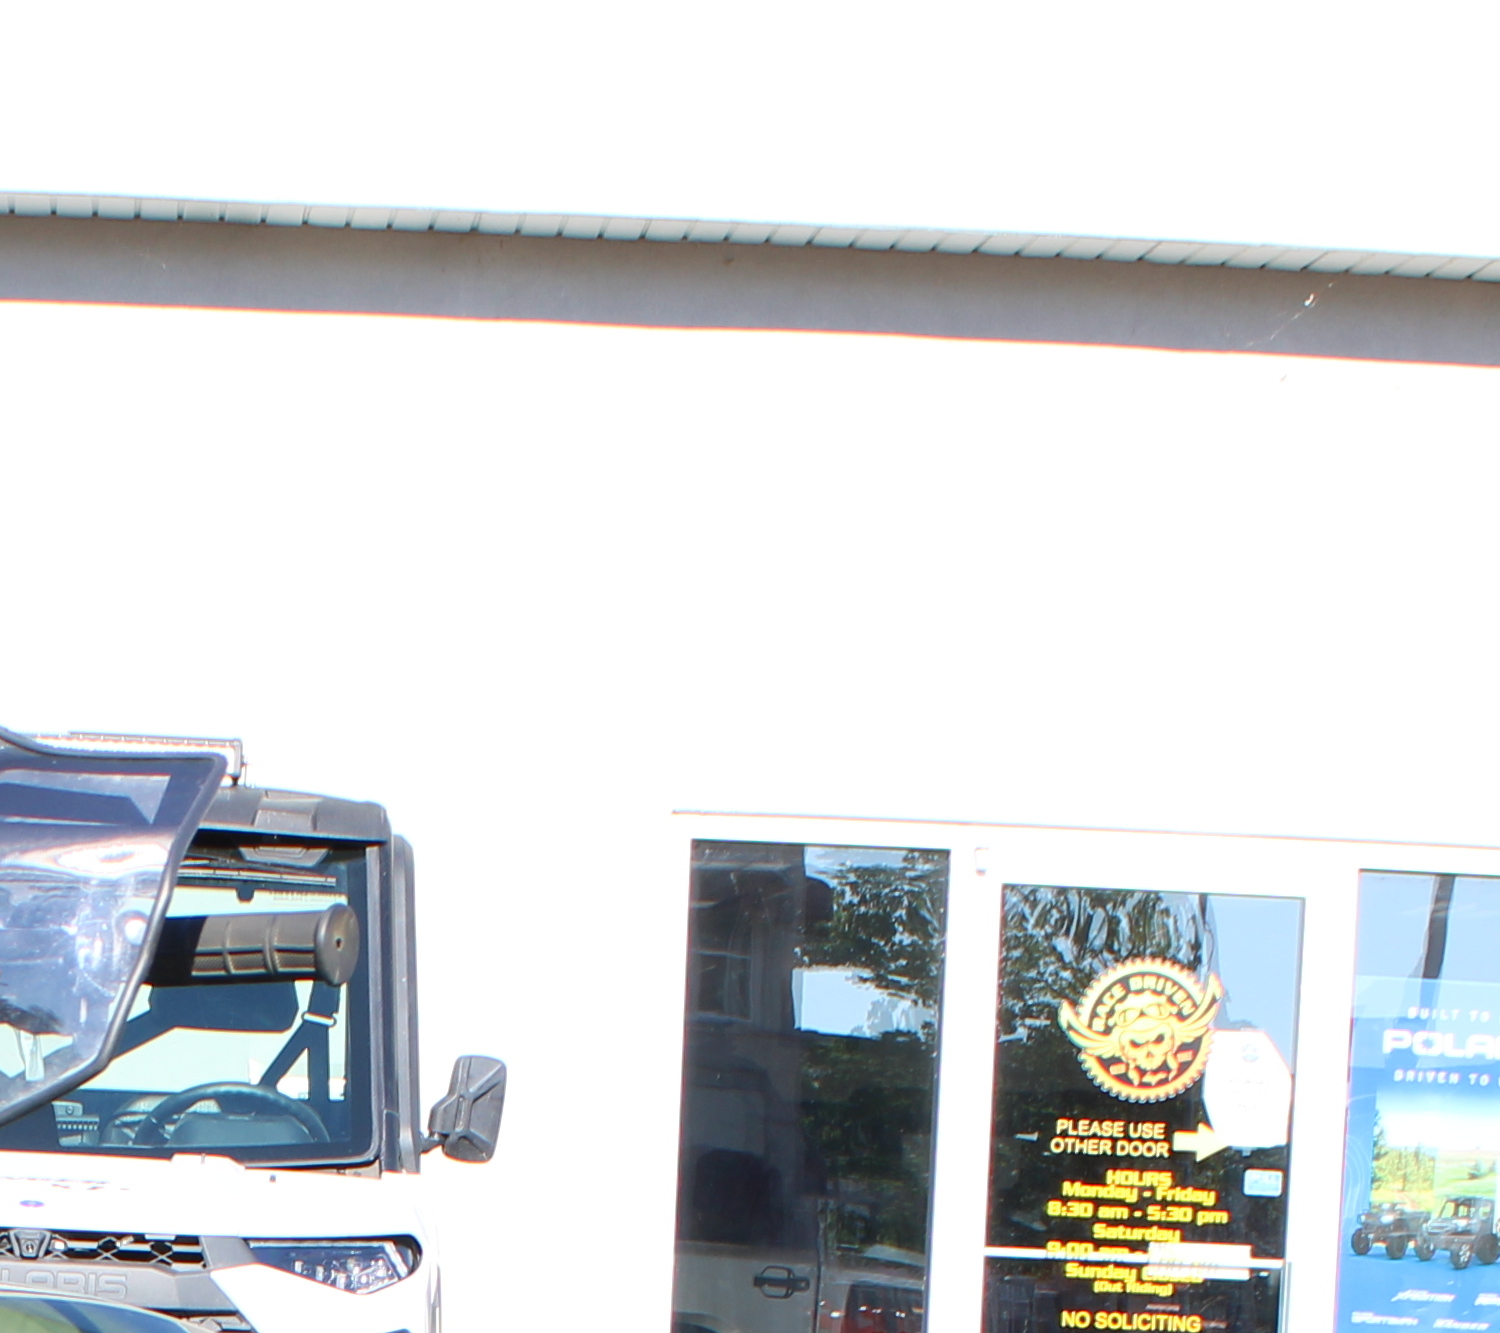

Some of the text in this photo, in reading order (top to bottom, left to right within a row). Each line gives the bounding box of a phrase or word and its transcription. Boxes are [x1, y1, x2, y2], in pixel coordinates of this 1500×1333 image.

[1091, 974, 1197, 1032] RACE DRIVEN
[1407, 1006, 1460, 1021] BUILT
[1469, 1009, 1491, 1024] TO
[1393, 1069, 1460, 1085] DRIVEN
[1468, 1073, 1490, 1087] TO
[1056, 1118, 1166, 1139] PLEASE USE
[1050, 1137, 1170, 1158] OTHER DOOR
[1106, 1169, 1172, 1187] HOURS
[1062, 1181, 1139, 1203] Monday
[1156, 1186, 1217, 1207] Friday
[1047, 1201, 1094, 1219] 8:30
[1097, 1205, 1129, 1220] am
[1146, 1205, 1194, 1222] 5:30
[1196, 1209, 1229, 1226] pm
[1092, 1223, 1182, 1242] Saturday
[1065, 1262, 1137, 1283] Sunday
[1060, 1311, 1203, 1333] NO SOLICITING
